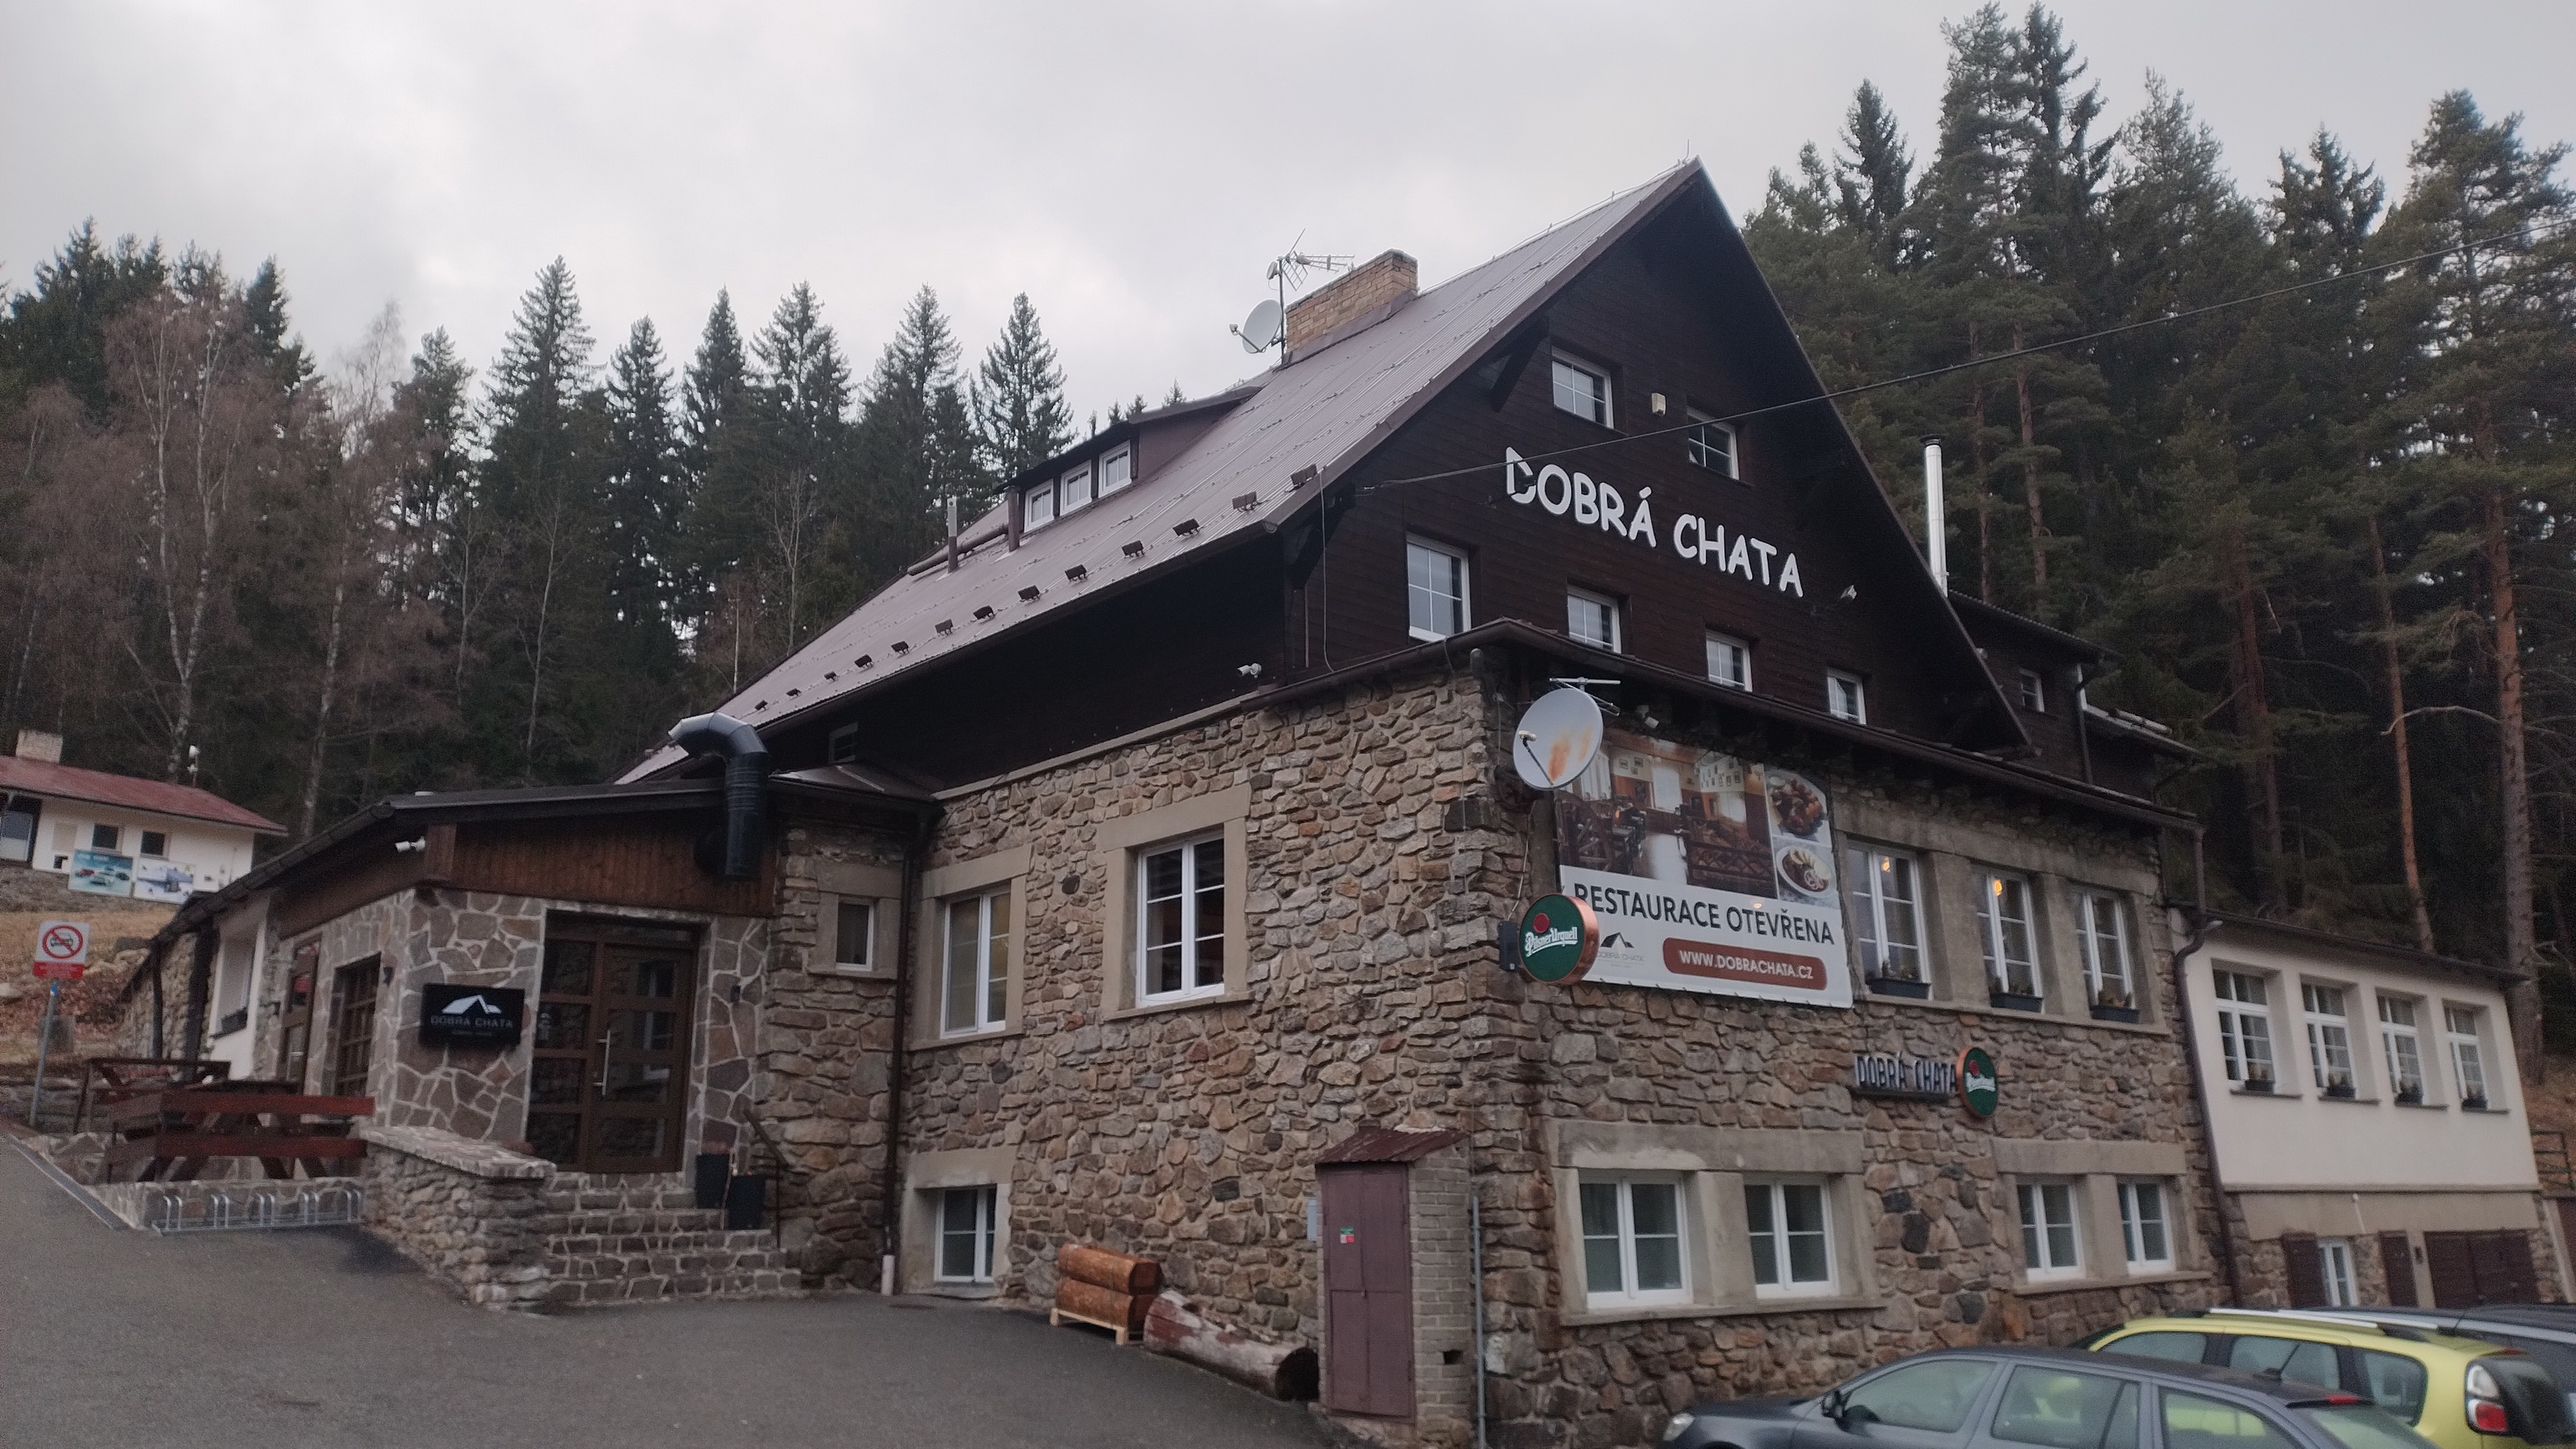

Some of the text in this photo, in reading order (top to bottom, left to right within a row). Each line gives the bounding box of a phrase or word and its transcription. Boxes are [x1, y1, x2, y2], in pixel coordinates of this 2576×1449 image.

[1506, 447, 1804, 597] DOBRÁ CHATA
[1574, 883, 1835, 945] RESTAURACE OTEVŘENA
[1679, 949, 1814, 980] WWW.DOBRACHATA.CZ
[1854, 1051, 1907, 1088] DOBRÁ
